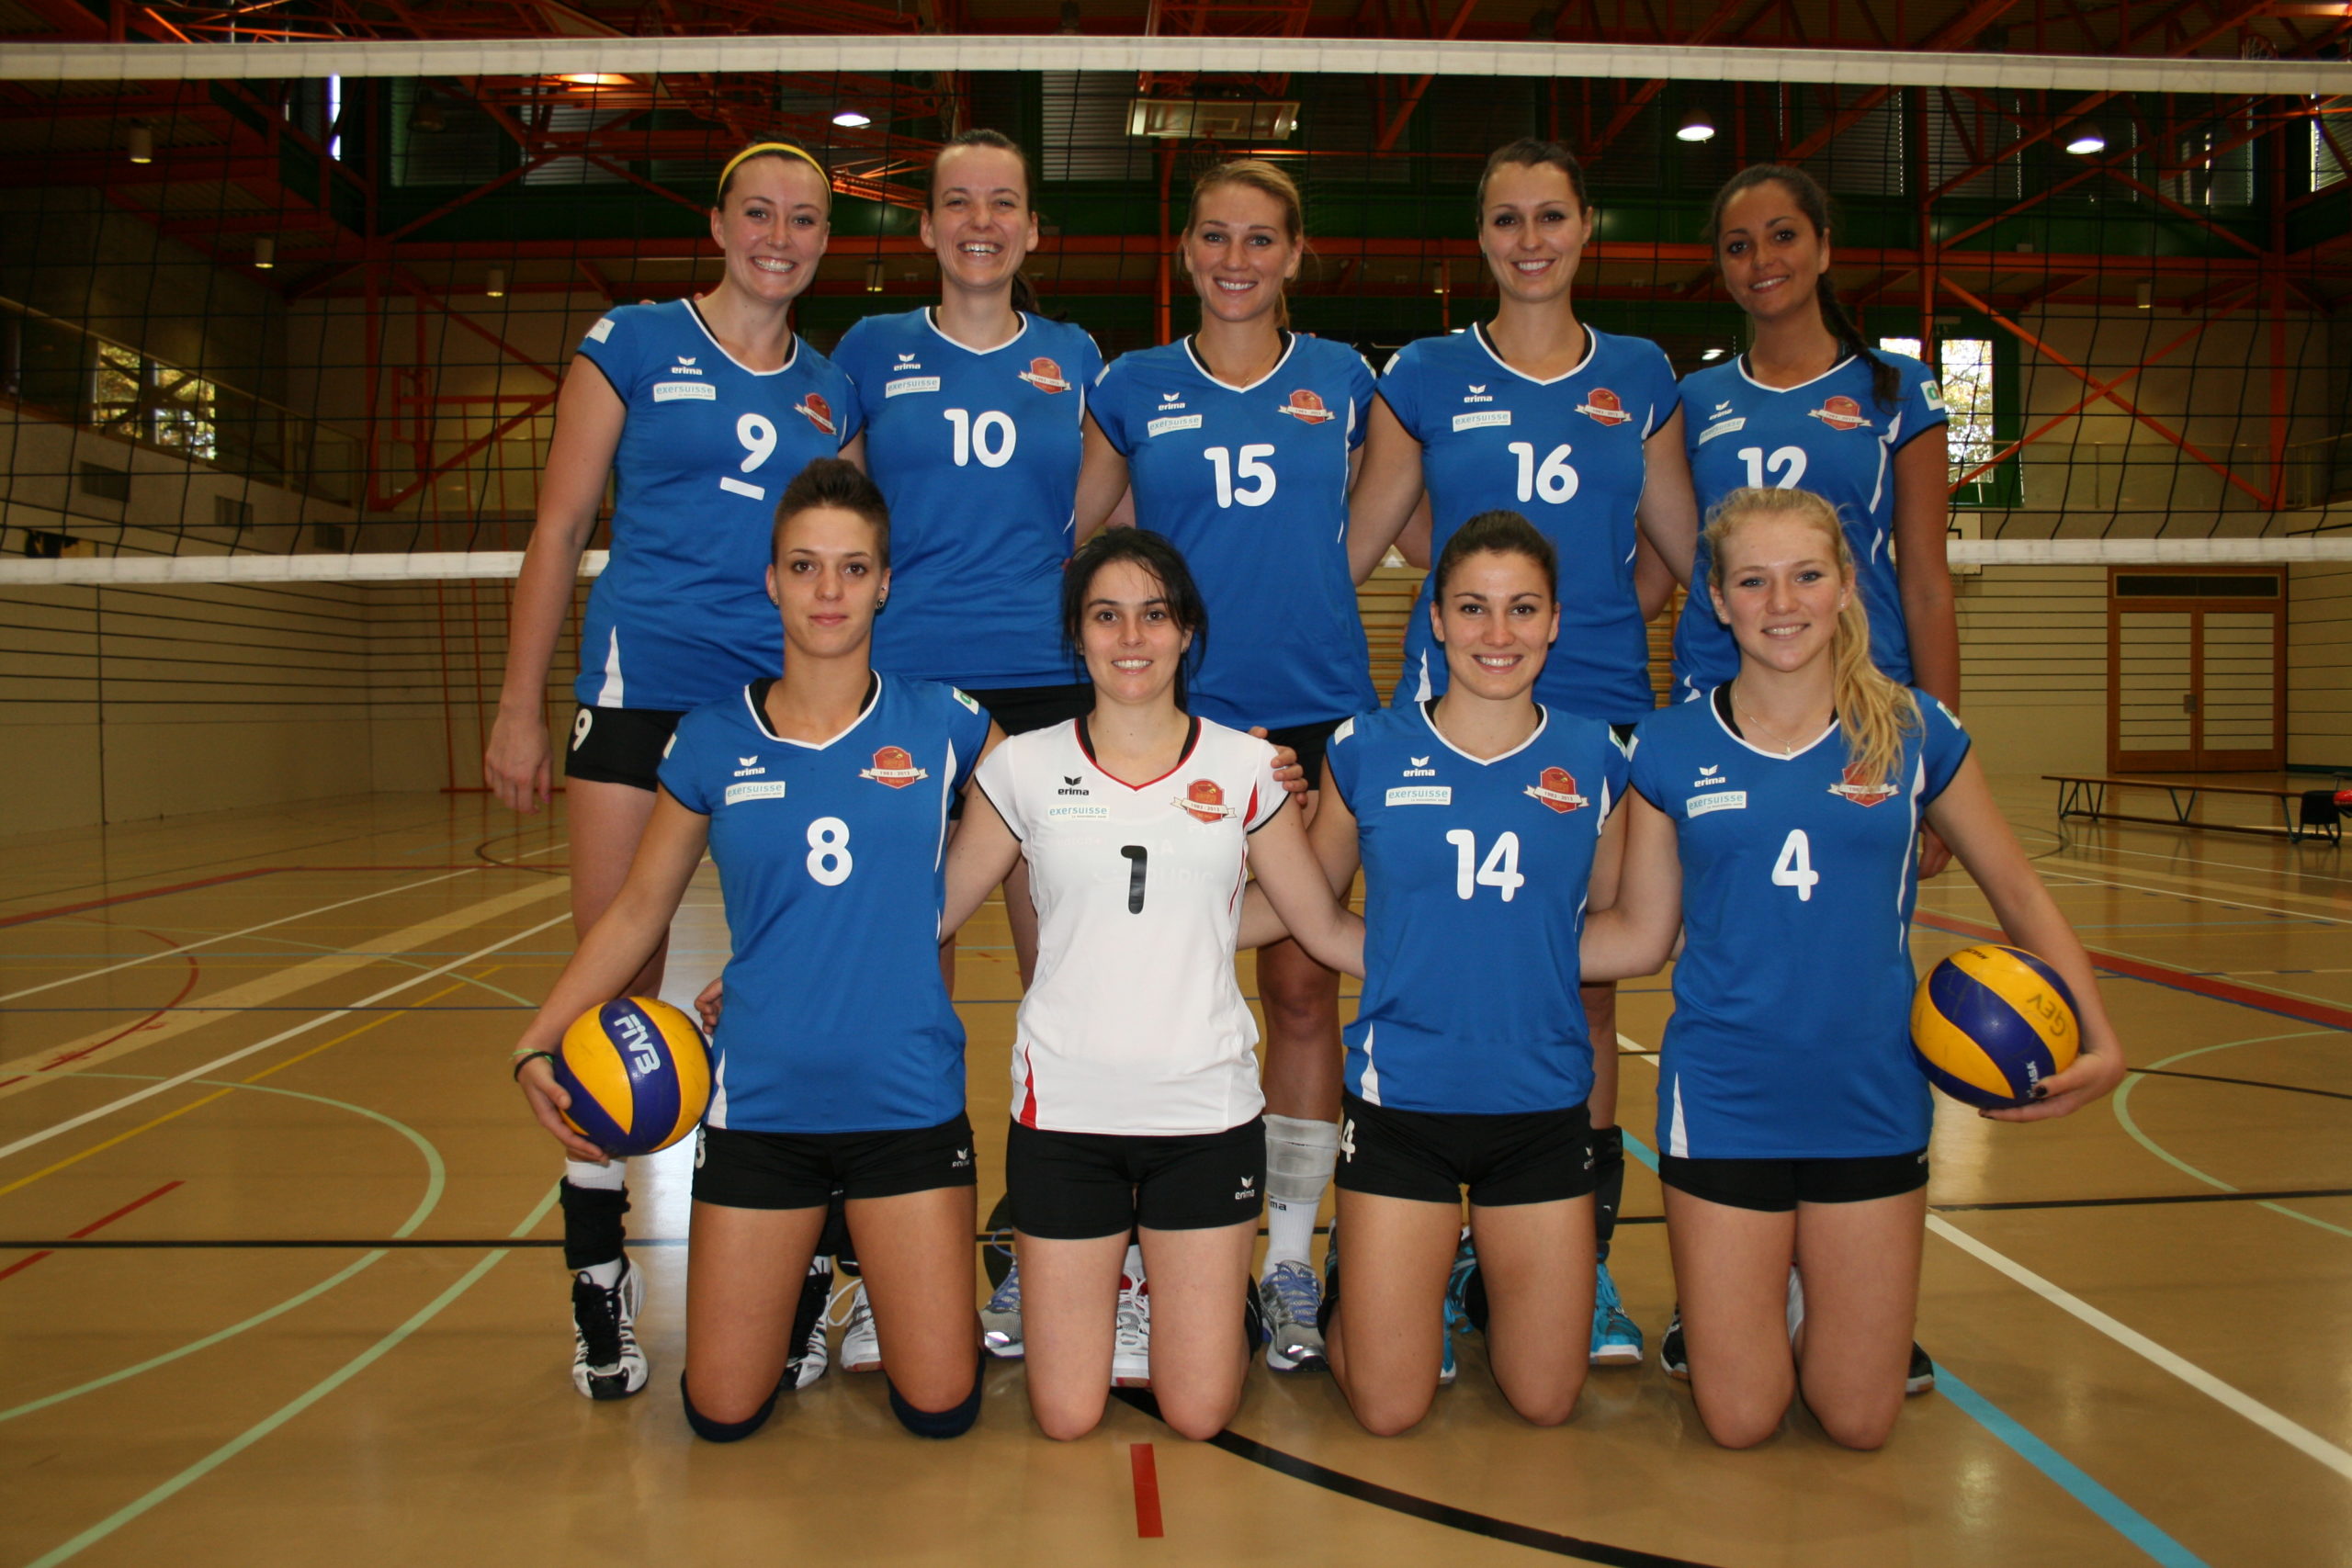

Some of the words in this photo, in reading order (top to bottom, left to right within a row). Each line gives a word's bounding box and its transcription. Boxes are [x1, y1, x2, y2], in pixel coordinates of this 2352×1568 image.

[671, 367, 703, 376] erima
[893, 363, 921, 372] erima
[656, 385, 714, 394] exersuisse
[888, 379, 938, 392] exersuisse
[1464, 394, 1493, 403] erima
[1158, 401, 1185, 412] erima
[1149, 417, 1200, 431] exersuisse
[1454, 412, 1510, 425] exersuisse
[737, 412, 777, 473] 9
[944, 408, 1017, 468] 10
[1508, 441, 1579, 504] 16
[1737, 446, 1807, 490] 12
[1204, 443, 1277, 509] 15
[573, 708, 593, 751] 9
[733, 766, 765, 777] erima
[1403, 768, 1435, 777] erima
[1694, 776, 1726, 788] erima
[727, 784, 782, 797] exersuisse
[1057, 786, 1090, 796] erima
[1388, 787, 1449, 800] exersuisse
[1689, 793, 1744, 810] exersuisse
[1049, 806, 1107, 817] exersuisse
[807, 816, 854, 886] 8
[1446, 829, 1525, 902] 14
[1771, 829, 1819, 902] 4
[1120, 845, 1148, 914] 1
[1235, 1189, 1255, 1201] erima
